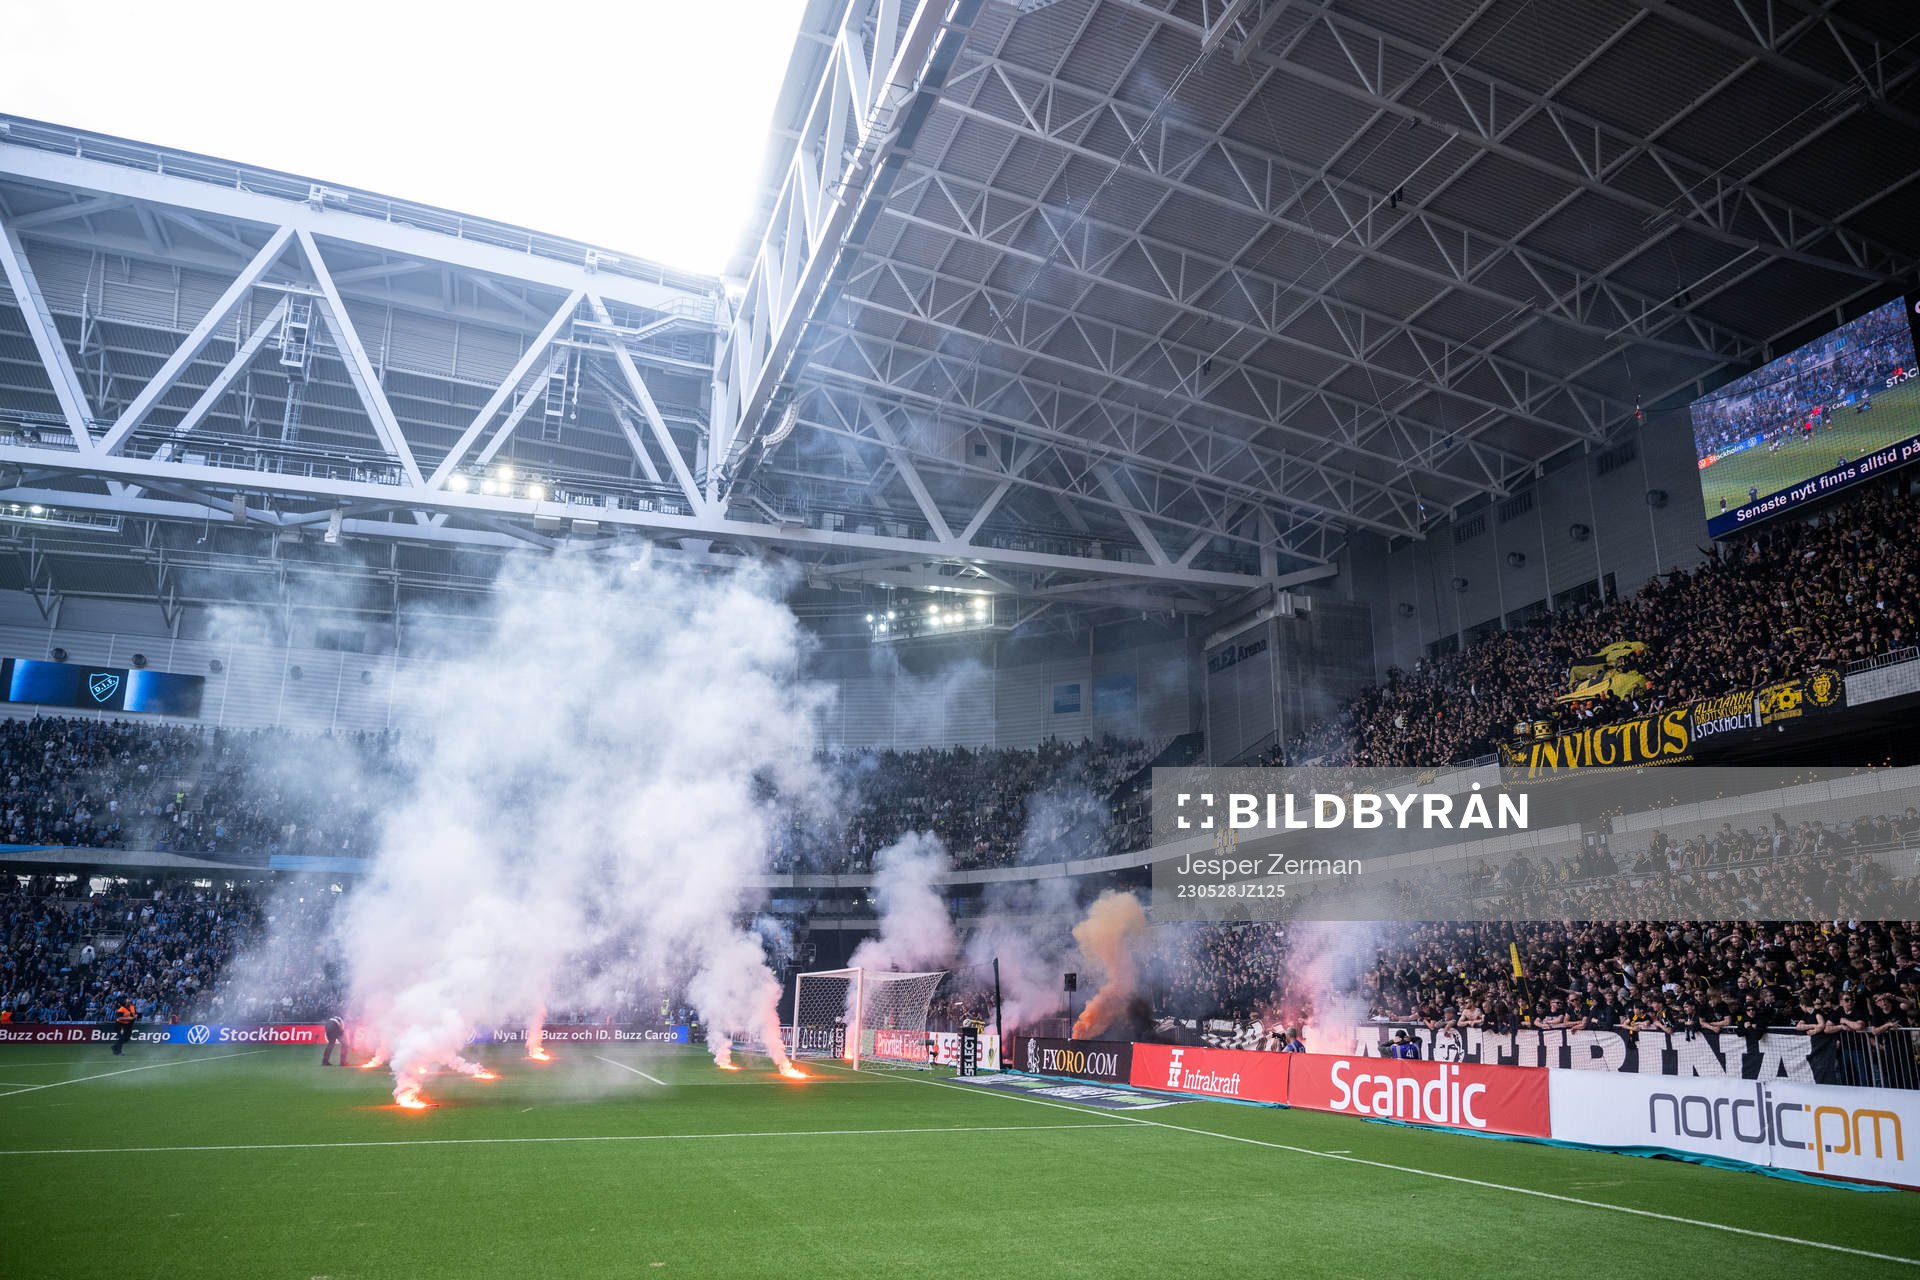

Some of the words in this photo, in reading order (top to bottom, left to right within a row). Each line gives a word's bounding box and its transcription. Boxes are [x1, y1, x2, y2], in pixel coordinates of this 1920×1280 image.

[1736, 491, 1788, 522] Senaste
[1791, 480, 1816, 502] nytt
[1819, 467, 1857, 490] finns
[1860, 447, 1898, 475] alltid
[1696, 713, 1753, 739] STOCKHOLM
[1527, 709, 1689, 779] INVICTUS
[0, 1029, 33, 1041] Buzz
[36, 1029, 63, 1041] och
[67, 1029, 87, 1041] ID.
[91, 1029, 122, 1041] Buz
[130, 1029, 171, 1043] Cargo
[219, 1027, 313, 1042] Stockholm
[493, 1030, 518, 1043] Nya
[571, 1029, 593, 1041] och
[596, 1029, 611, 1041] ID.
[614, 1029, 642, 1041] Buzz
[644, 1029, 678, 1042] Cargo
[835, 1028, 845, 1058] SELECT
[964, 1035, 975, 1076] SELECT
[1042, 1048, 1118, 1076] FXORO.COM
[1183, 1069, 1241, 1095] Infrakraft
[1329, 1060, 1487, 1128] Scandic
